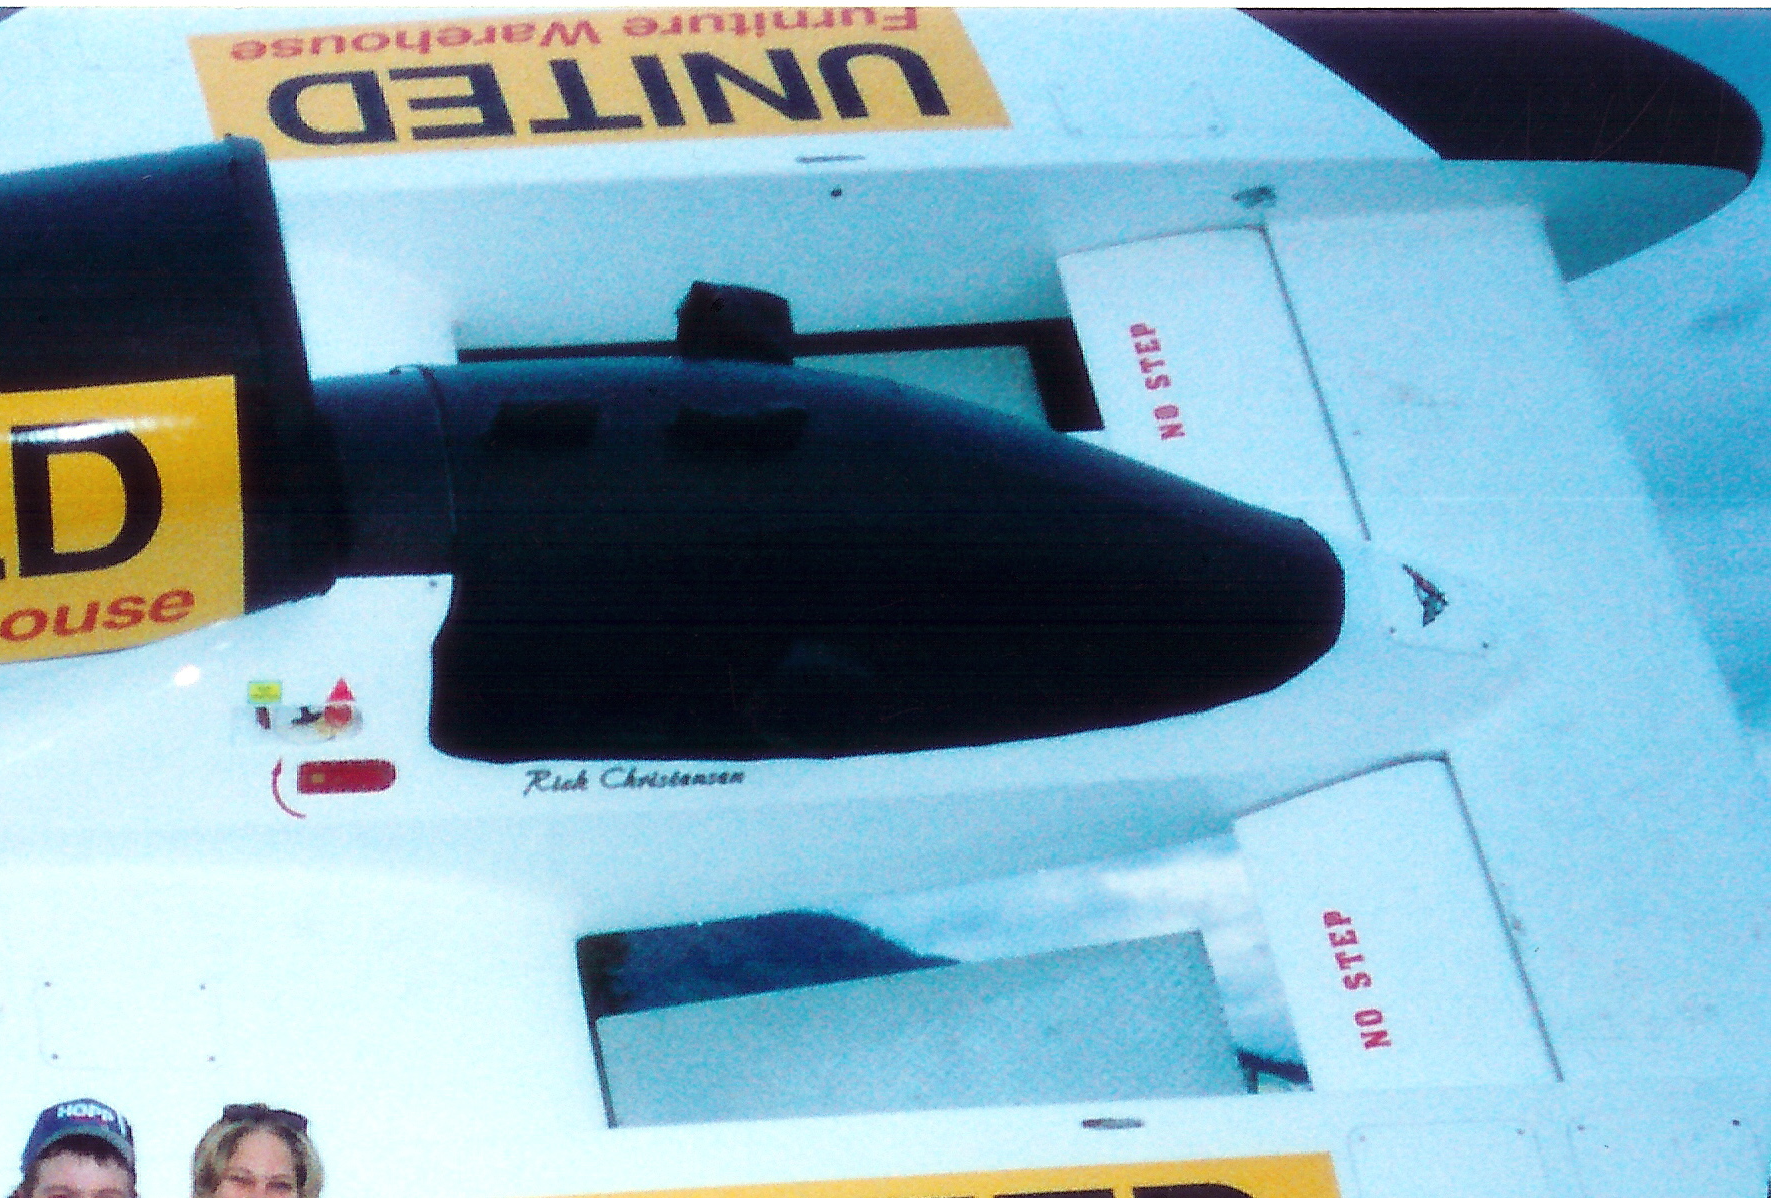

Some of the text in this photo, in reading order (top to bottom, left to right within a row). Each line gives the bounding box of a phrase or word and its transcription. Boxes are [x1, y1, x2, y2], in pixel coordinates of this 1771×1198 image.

[229, 7, 919, 63] Furniture Warehouse
[267, 42, 951, 147] UNITED
[1130, 322, 1186, 441] NO STEP
[1322, 910, 1393, 1050] NO STEP
